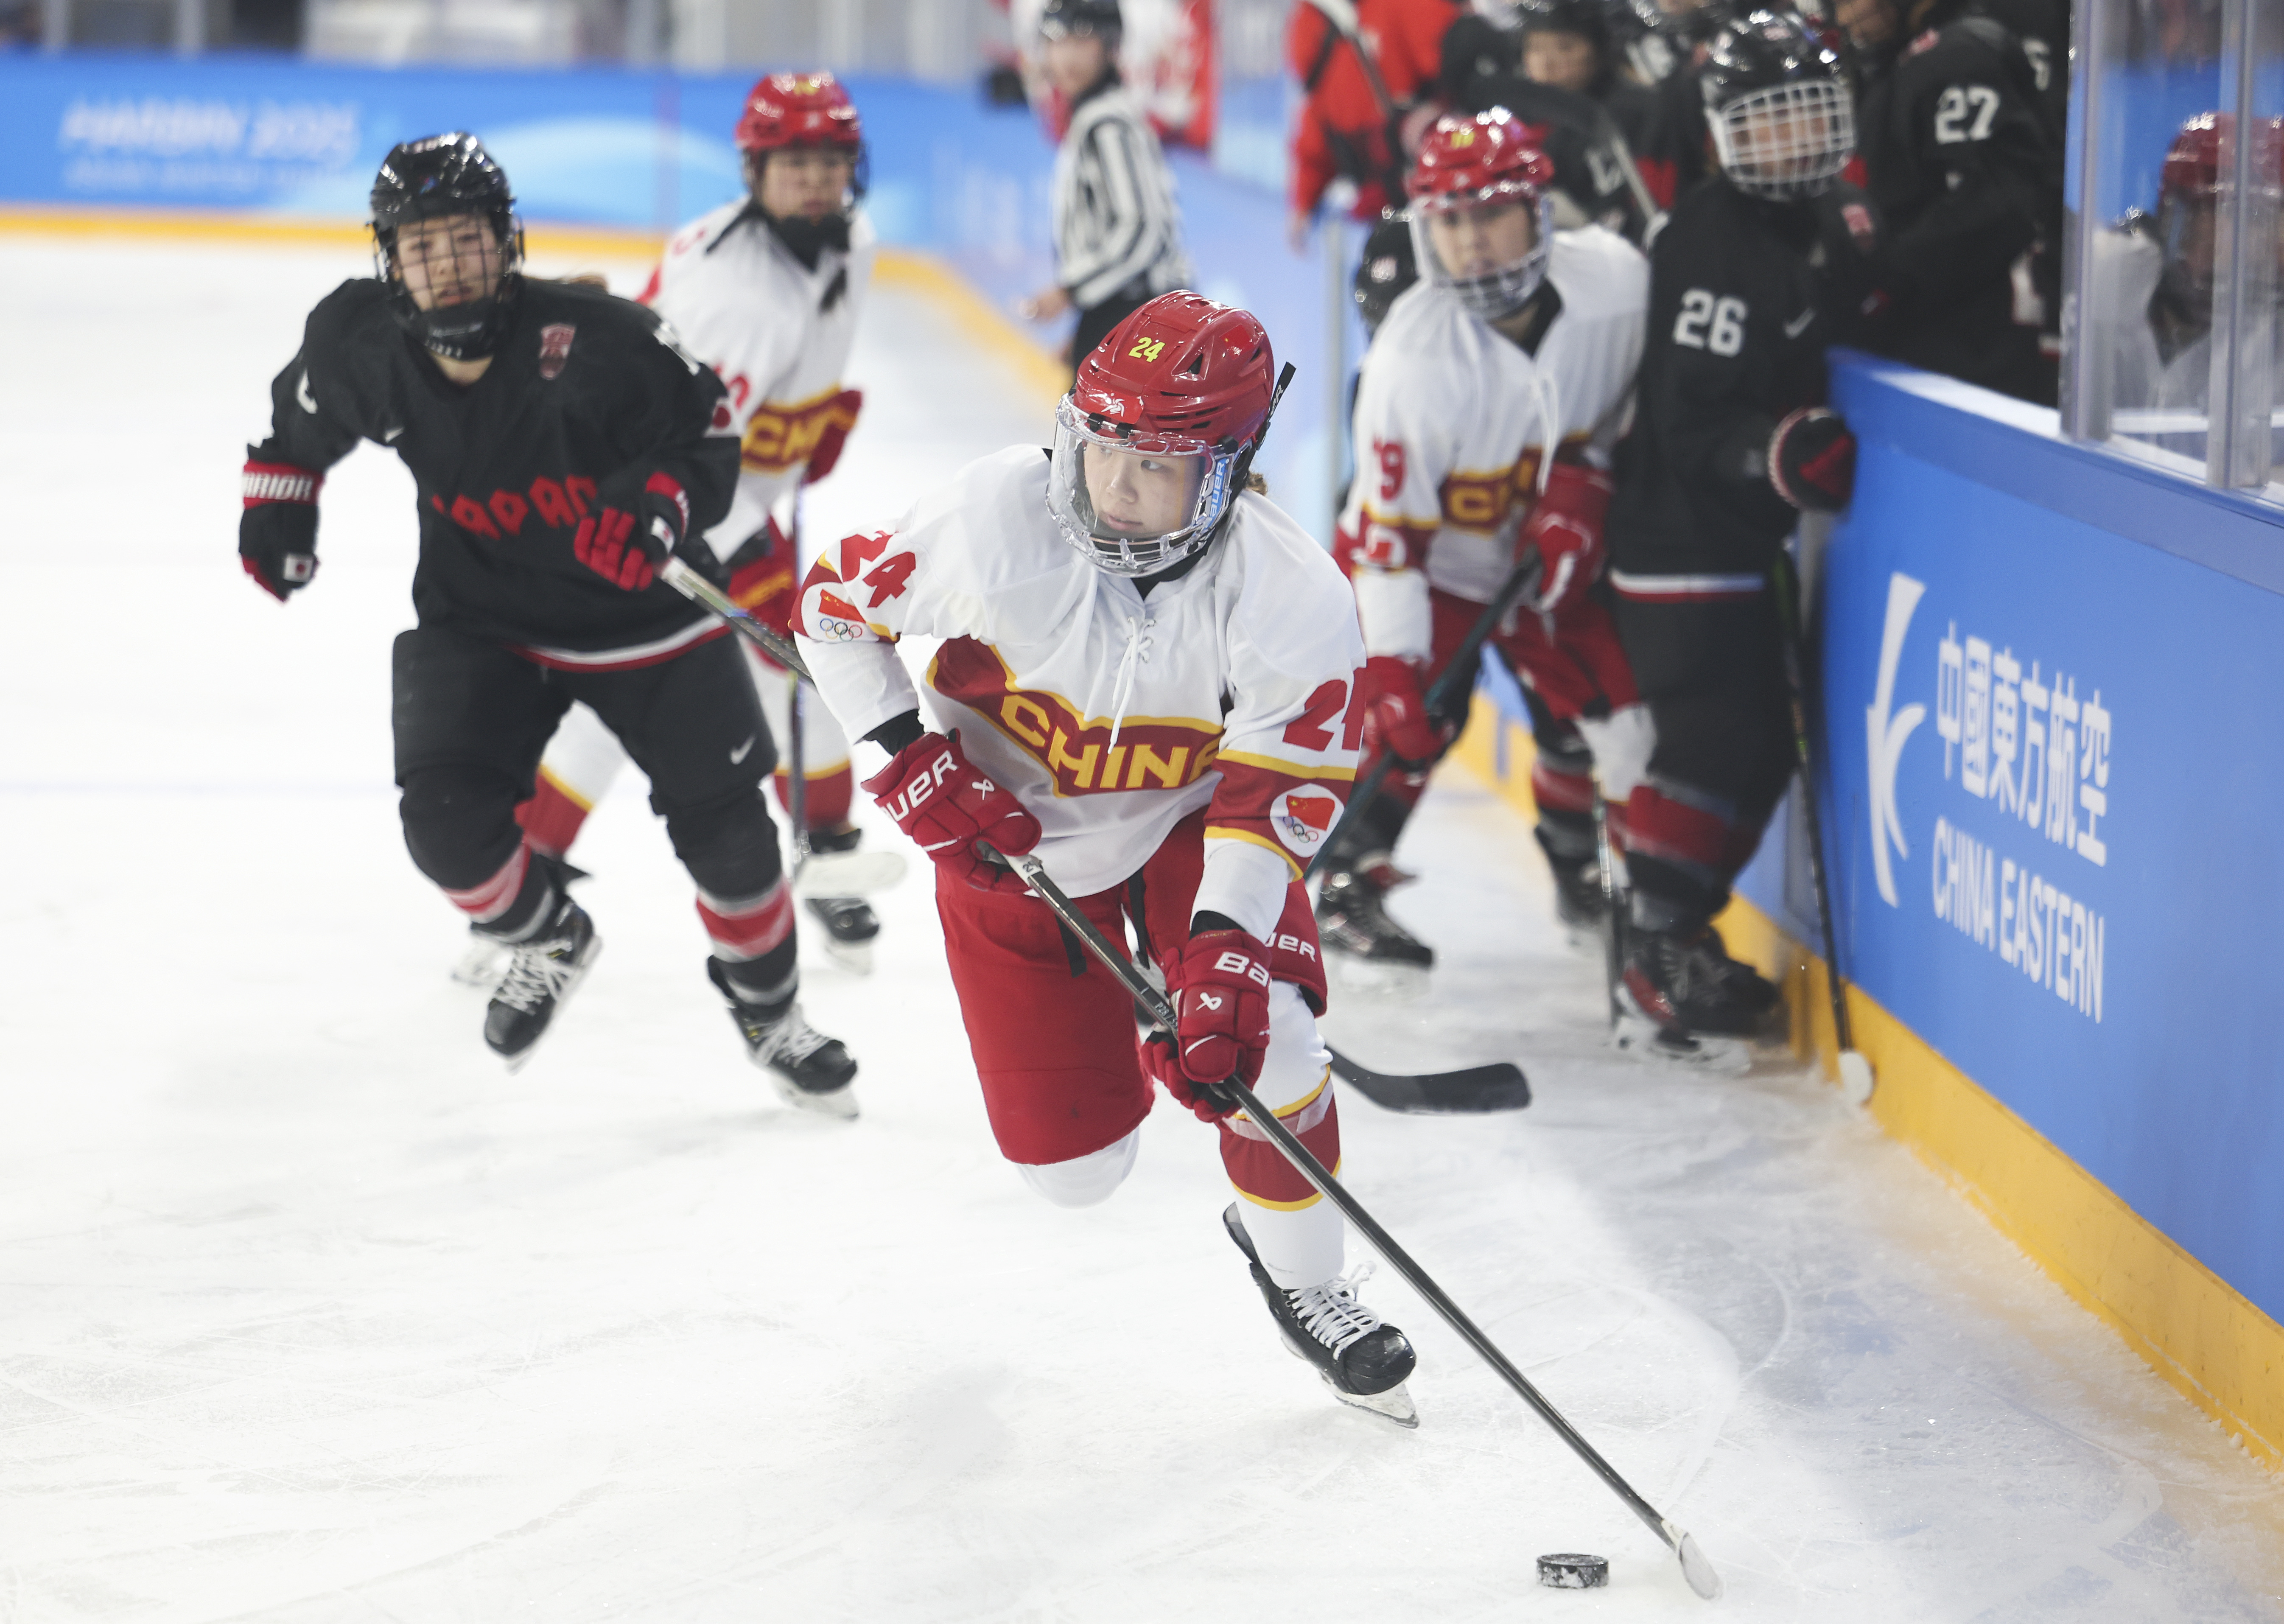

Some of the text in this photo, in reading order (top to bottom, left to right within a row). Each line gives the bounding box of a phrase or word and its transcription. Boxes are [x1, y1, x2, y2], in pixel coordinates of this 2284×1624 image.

[1936, 87, 1999, 143] 27
[1128, 337, 1165, 363] 24
[1675, 288, 1747, 356] 26
[1936, 619, 2111, 868] 中國東方航空
[1932, 815, 2104, 1024] CHINA EASTERN
